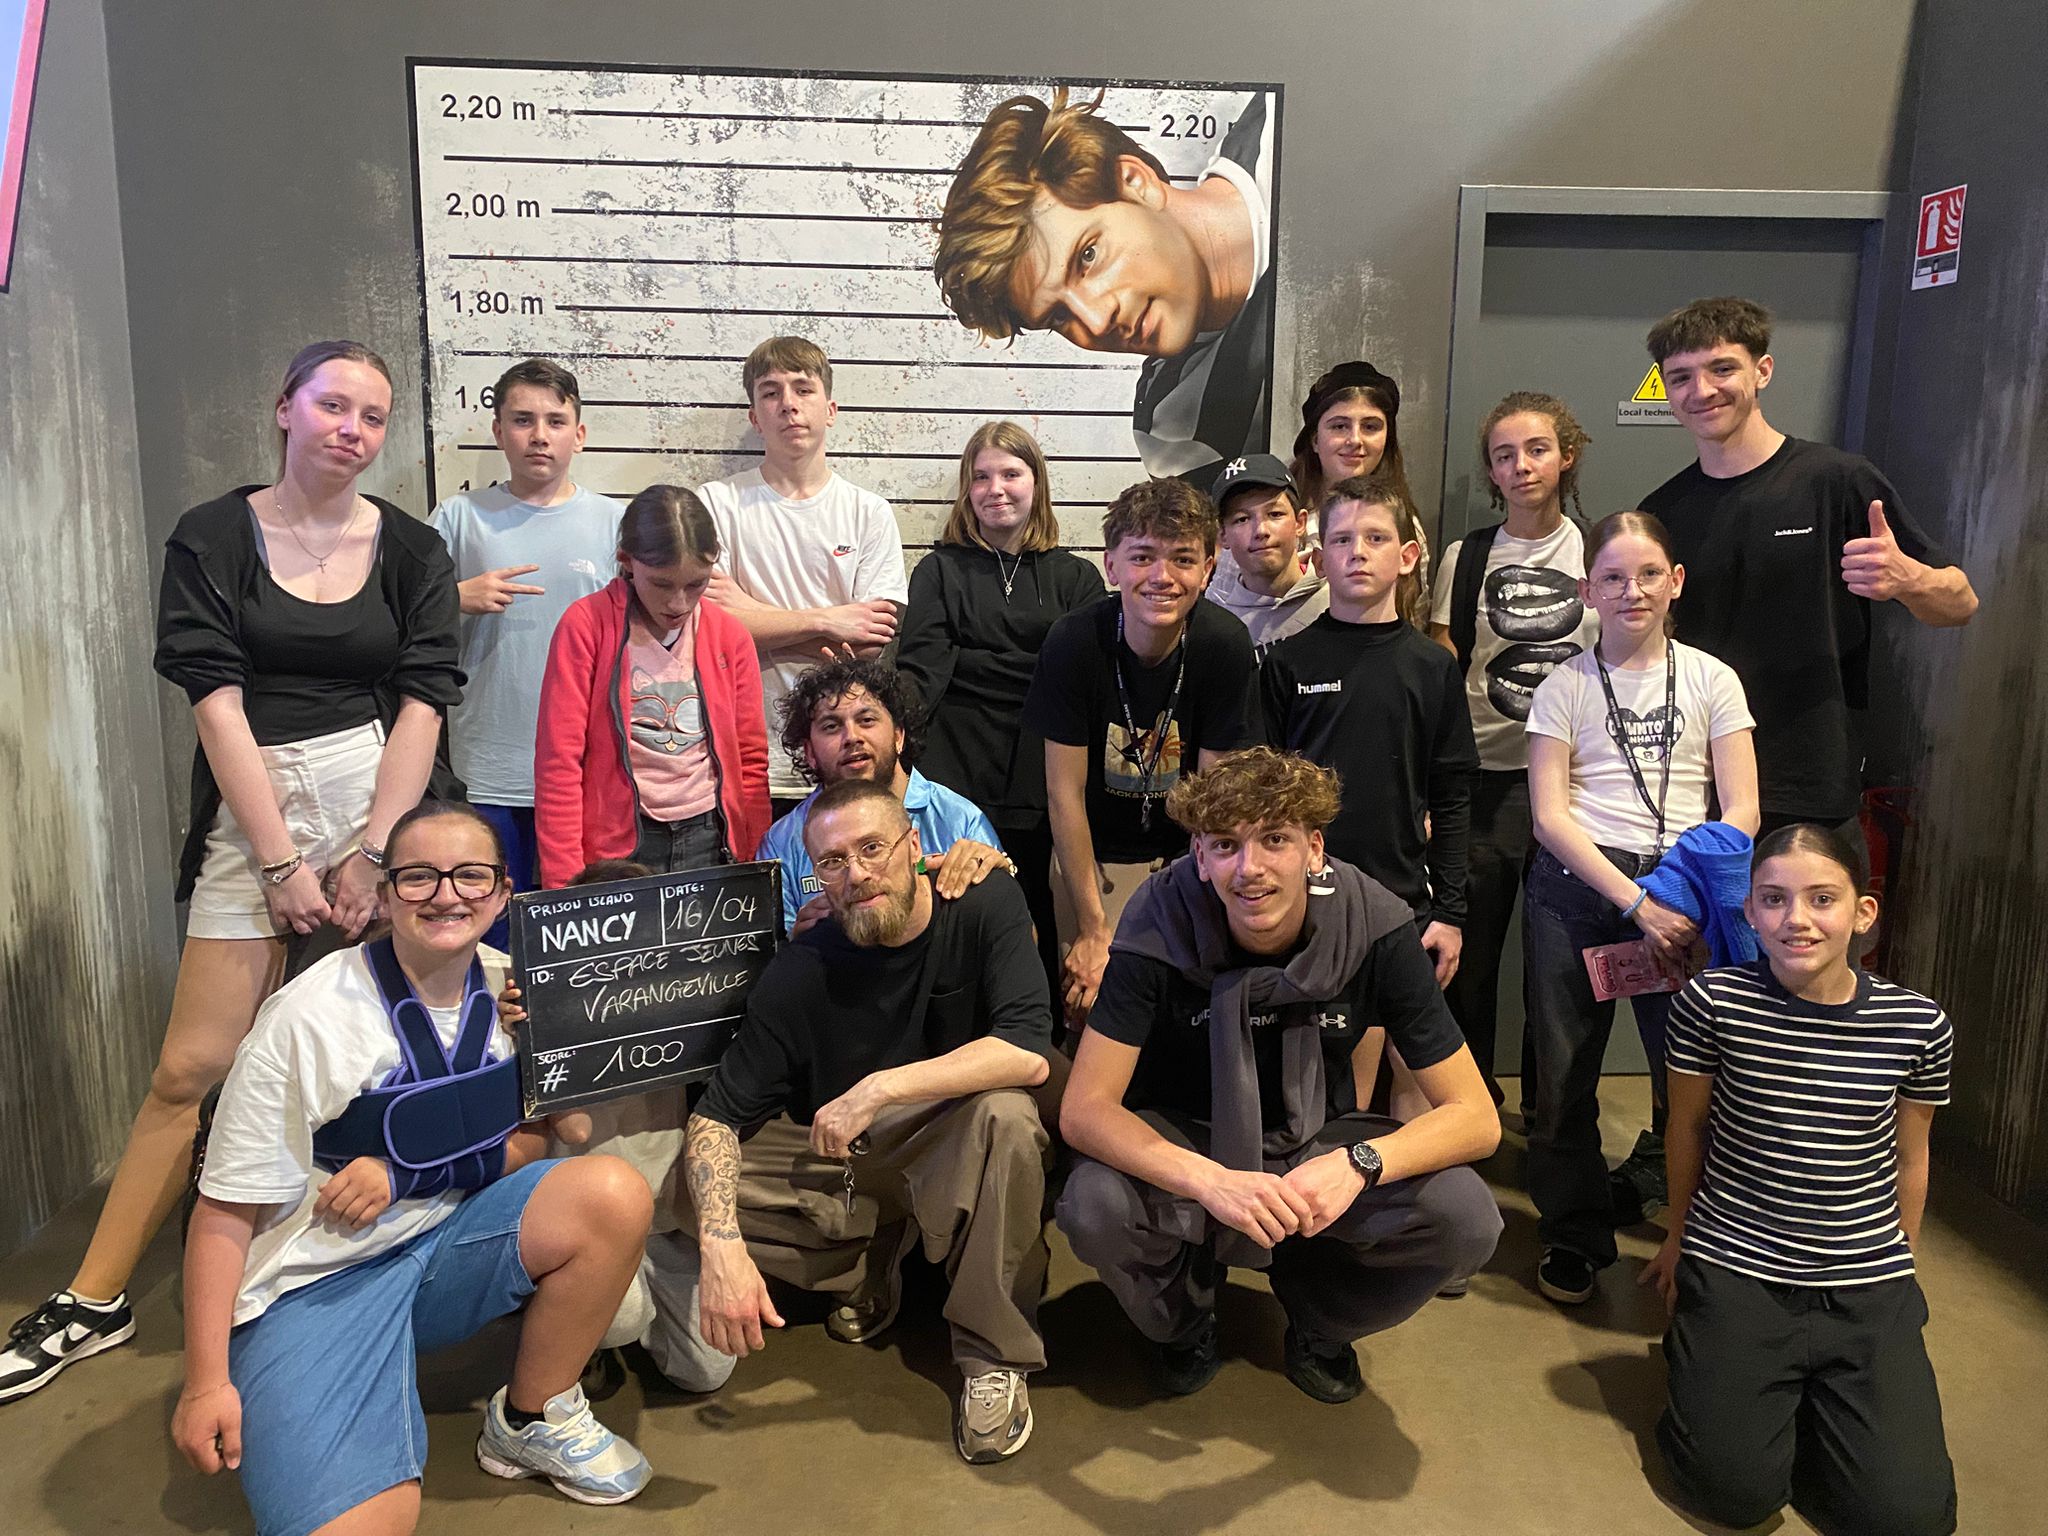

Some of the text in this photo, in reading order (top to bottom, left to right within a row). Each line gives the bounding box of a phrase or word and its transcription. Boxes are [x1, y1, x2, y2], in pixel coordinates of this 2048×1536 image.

[441, 93, 535, 121] 2,20 m
[1160, 114, 1217, 141] 2,20
[447, 193, 540, 218] 2,00 m
[450, 290, 543, 317] 1,80 m
[455, 385, 495, 413] 1,6
[1618, 407, 1675, 417] Local techni
[1297, 679, 1342, 695] hummel
[1607, 713, 1684, 737] DWNTON
[665, 882, 705, 899] DATE:
[527, 892, 634, 919] PRISON ISLAND
[666, 887, 758, 937] 16/04
[541, 911, 637, 953] NANCY
[531, 934, 761, 988] ID: ESPACE JEUNES
[583, 970, 749, 1024] VARANGEVILLE
[592, 1040, 684, 1083] 1000
